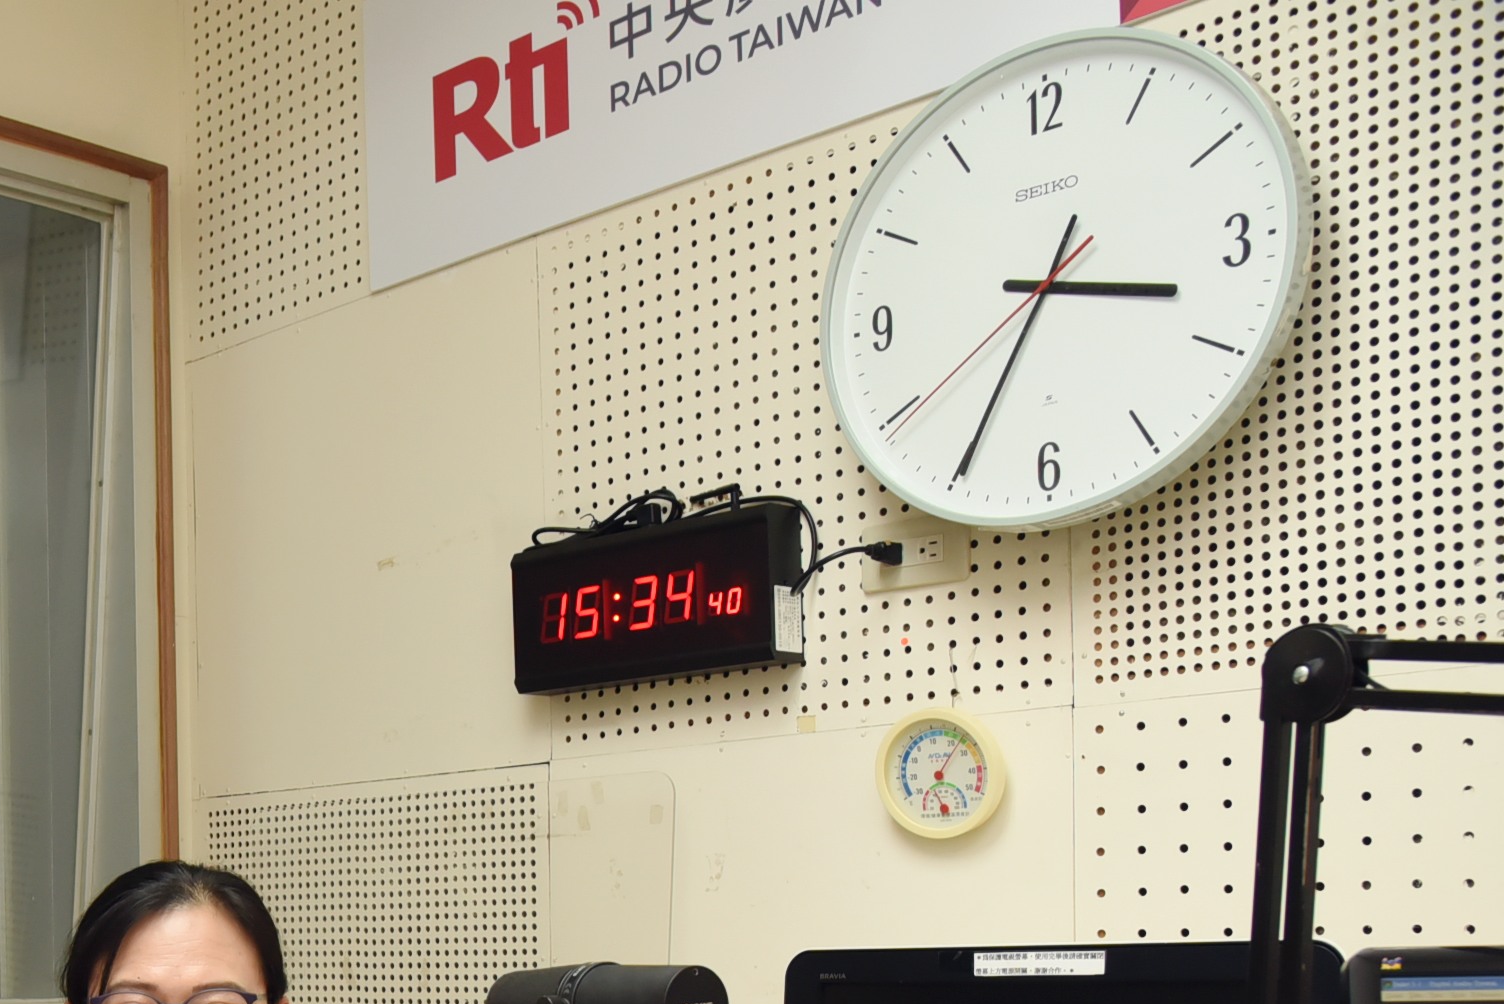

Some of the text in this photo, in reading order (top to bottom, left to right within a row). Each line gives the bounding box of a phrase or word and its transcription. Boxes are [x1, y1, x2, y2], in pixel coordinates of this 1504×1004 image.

[609, 0, 753, 59] 中央
[610, 44, 722, 113] RADIO
[432, 30, 571, 184] Rti
[1025, 81, 1065, 136] 12
[1015, 175, 1079, 204] SEIKO
[1222, 213, 1252, 267] 3
[871, 305, 894, 352] 9
[1036, 441, 1062, 491] 6
[557, 570, 743, 641] 15:34 40
[819, 972, 847, 980] BRAVIA
